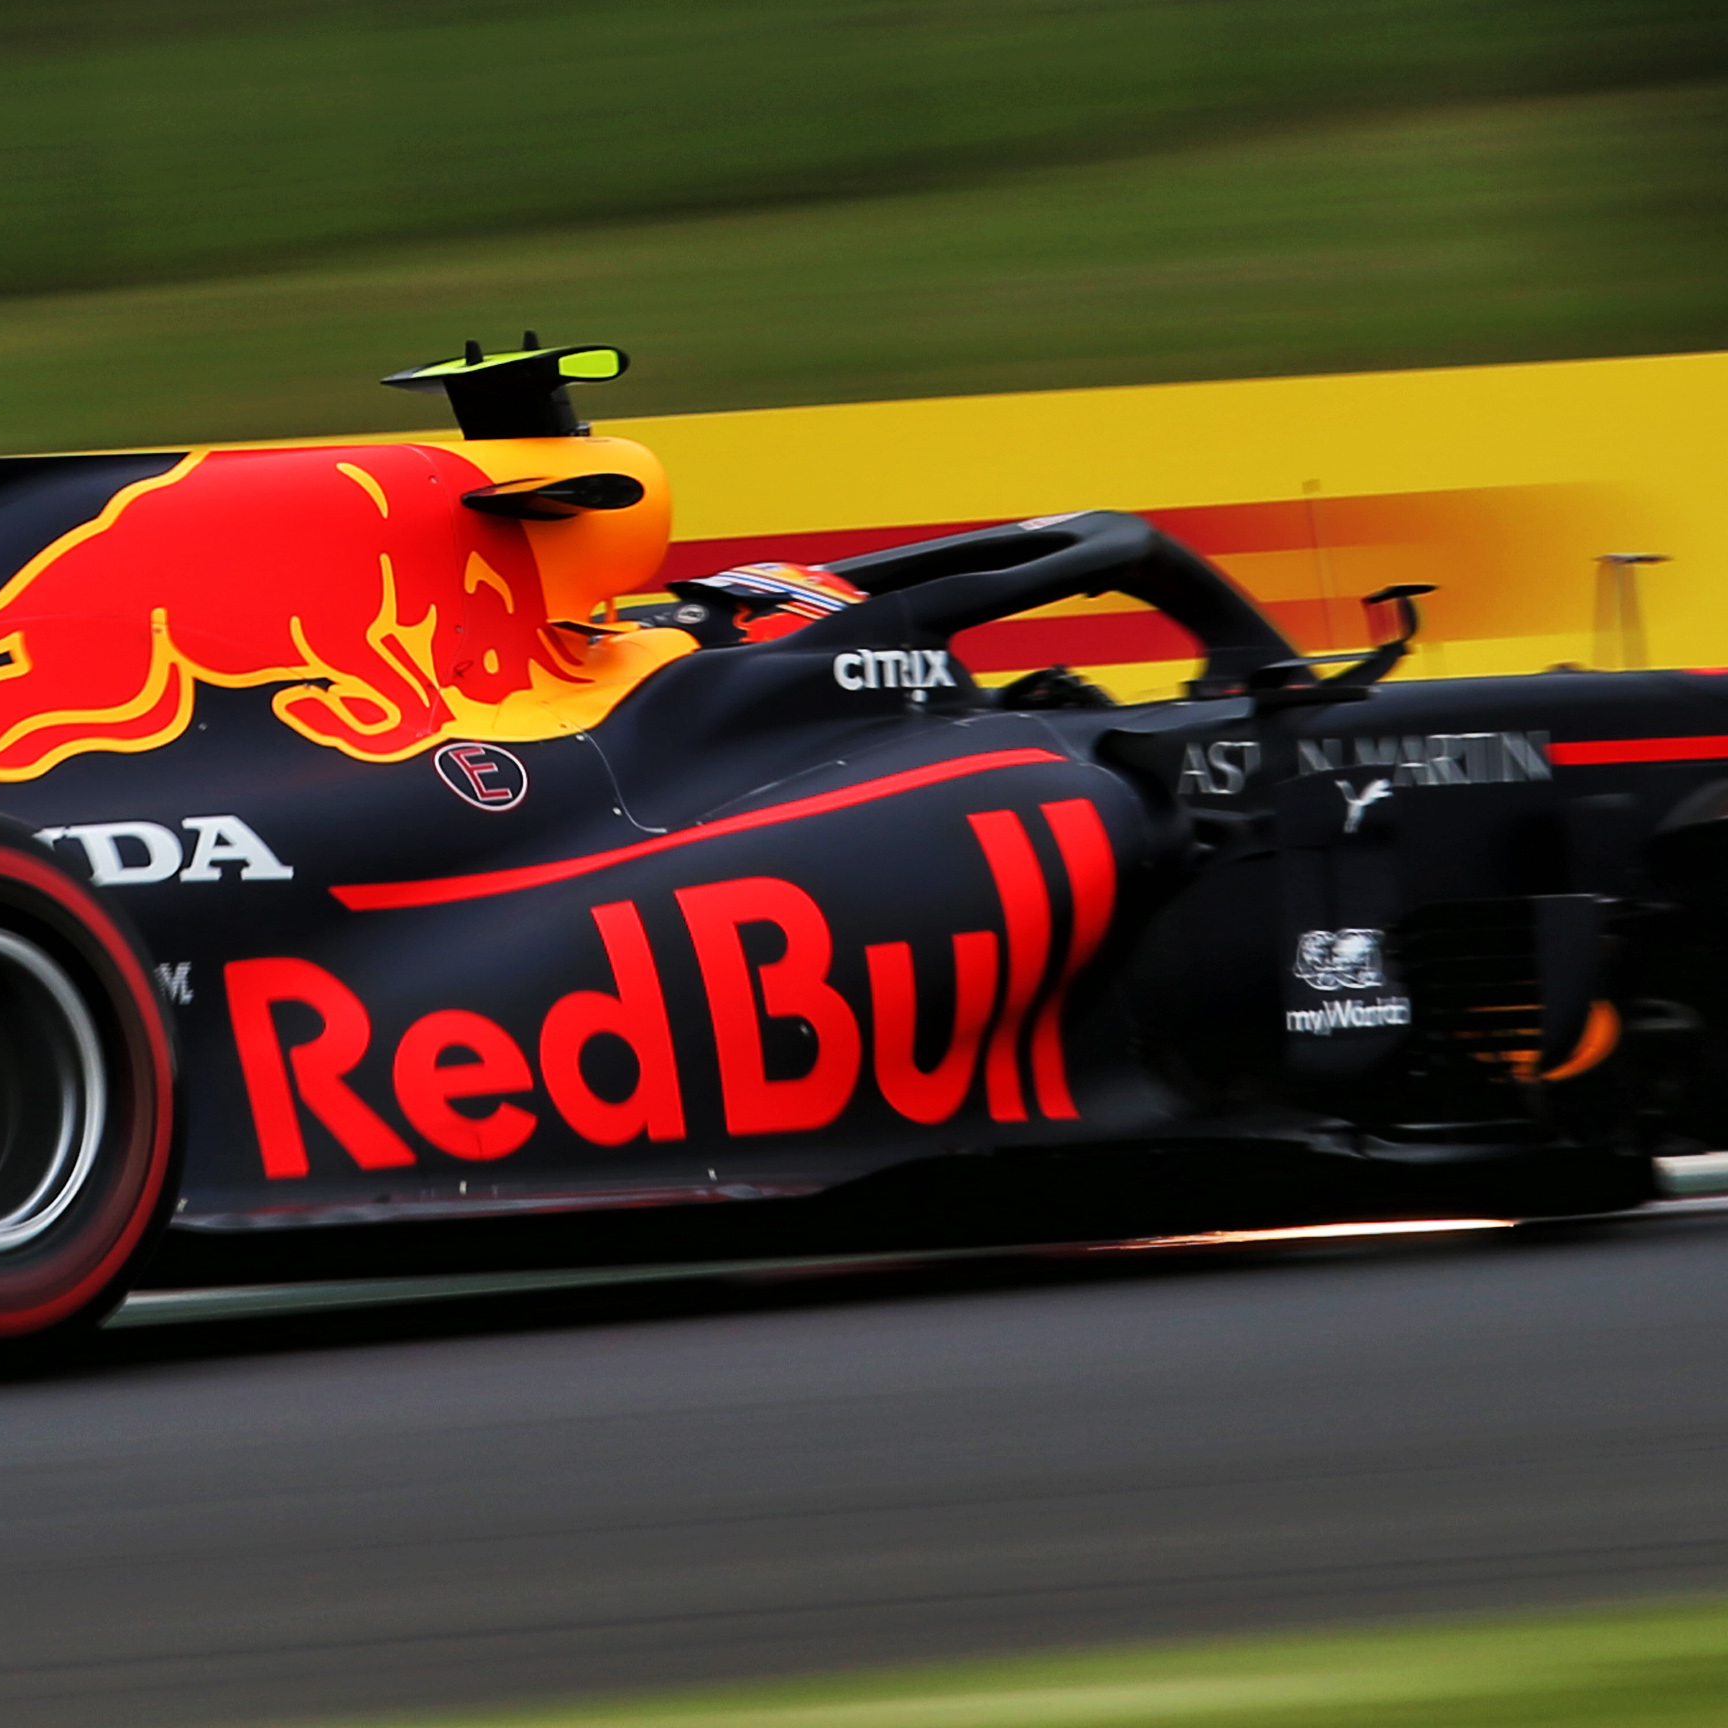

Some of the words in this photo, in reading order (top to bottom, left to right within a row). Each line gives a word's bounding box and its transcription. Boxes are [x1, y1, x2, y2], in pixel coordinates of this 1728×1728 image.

[448, 747, 513, 801] E
[1177, 738, 1344, 795] ASTN
[1353, 730, 1552, 787] MARTIN
[32, 815, 293, 887] DA
[224, 900, 686, 1179] Red
[676, 798, 1117, 1136] Bull
